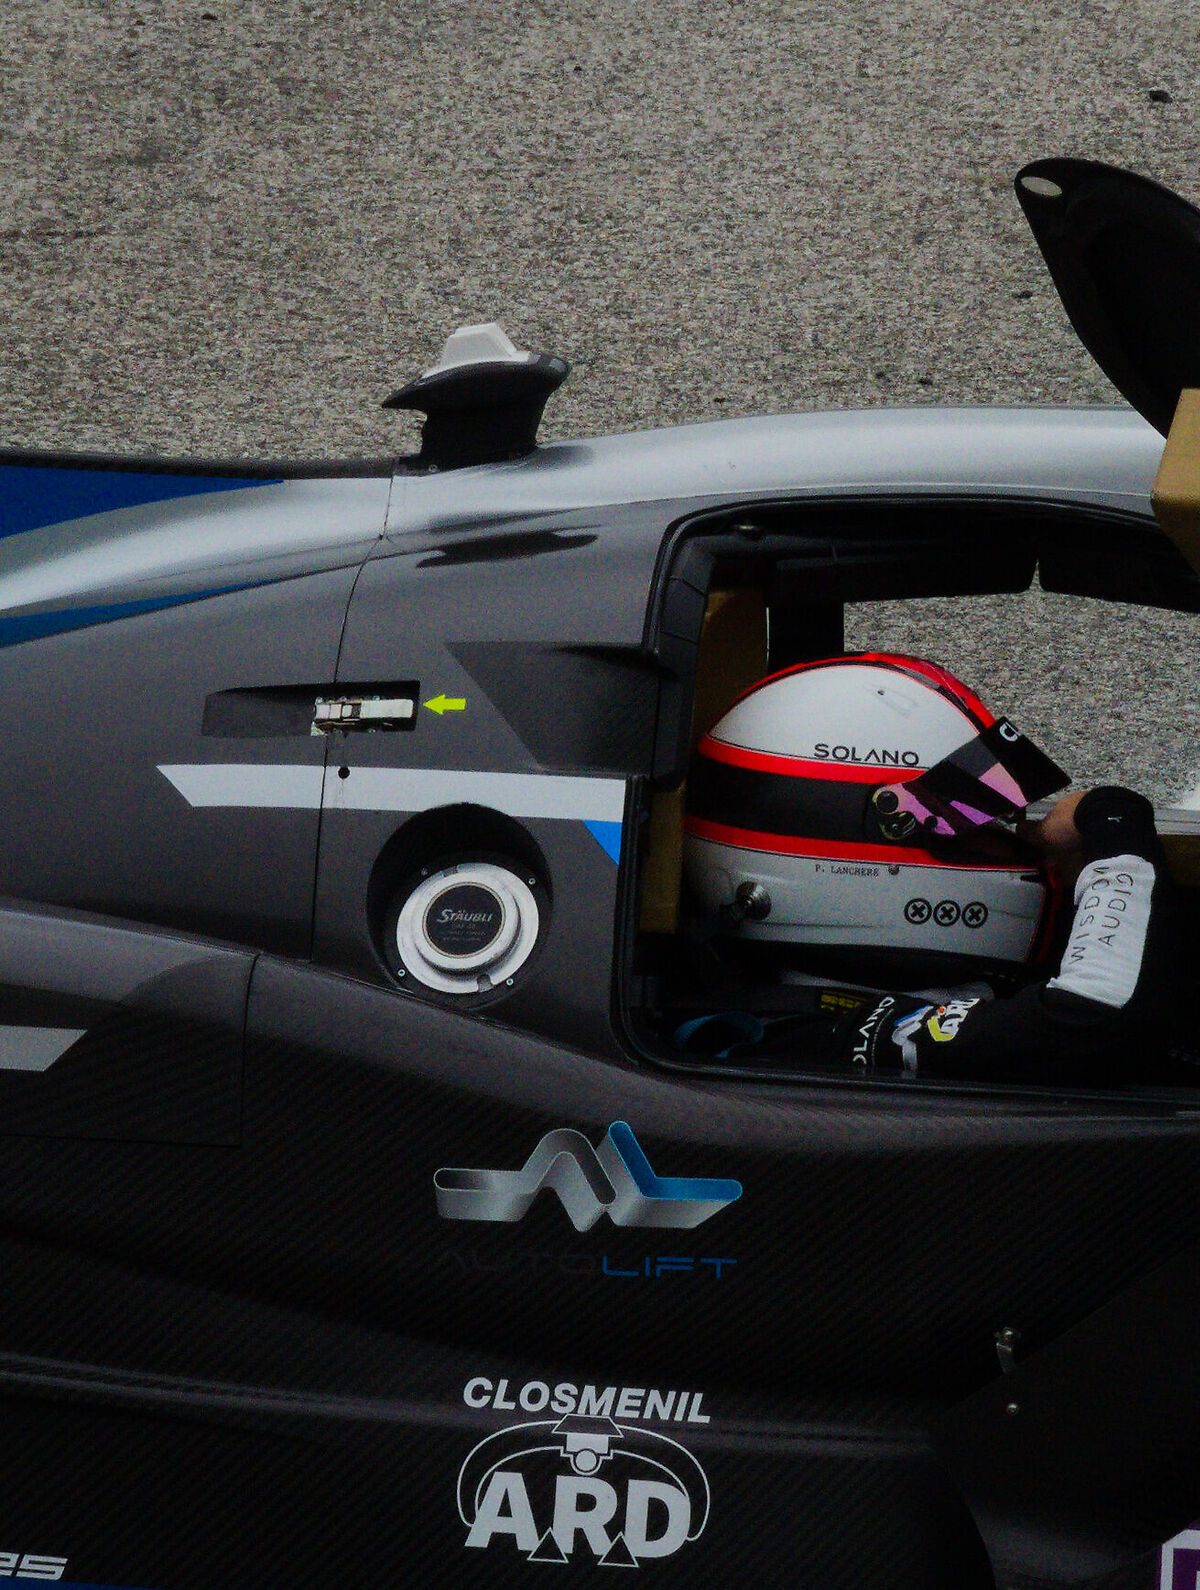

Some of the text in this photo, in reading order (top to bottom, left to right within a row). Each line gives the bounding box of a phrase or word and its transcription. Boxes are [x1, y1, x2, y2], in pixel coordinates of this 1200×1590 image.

[814, 743, 920, 766] SOLANO
[1068, 866, 1110, 965] WISDOM
[1098, 873, 1134, 947] AUDIO
[852, 996, 896, 1066] OLANO
[463, 1376, 711, 1424] CLOSMENIL
[464, 1471, 691, 1559] ARD
